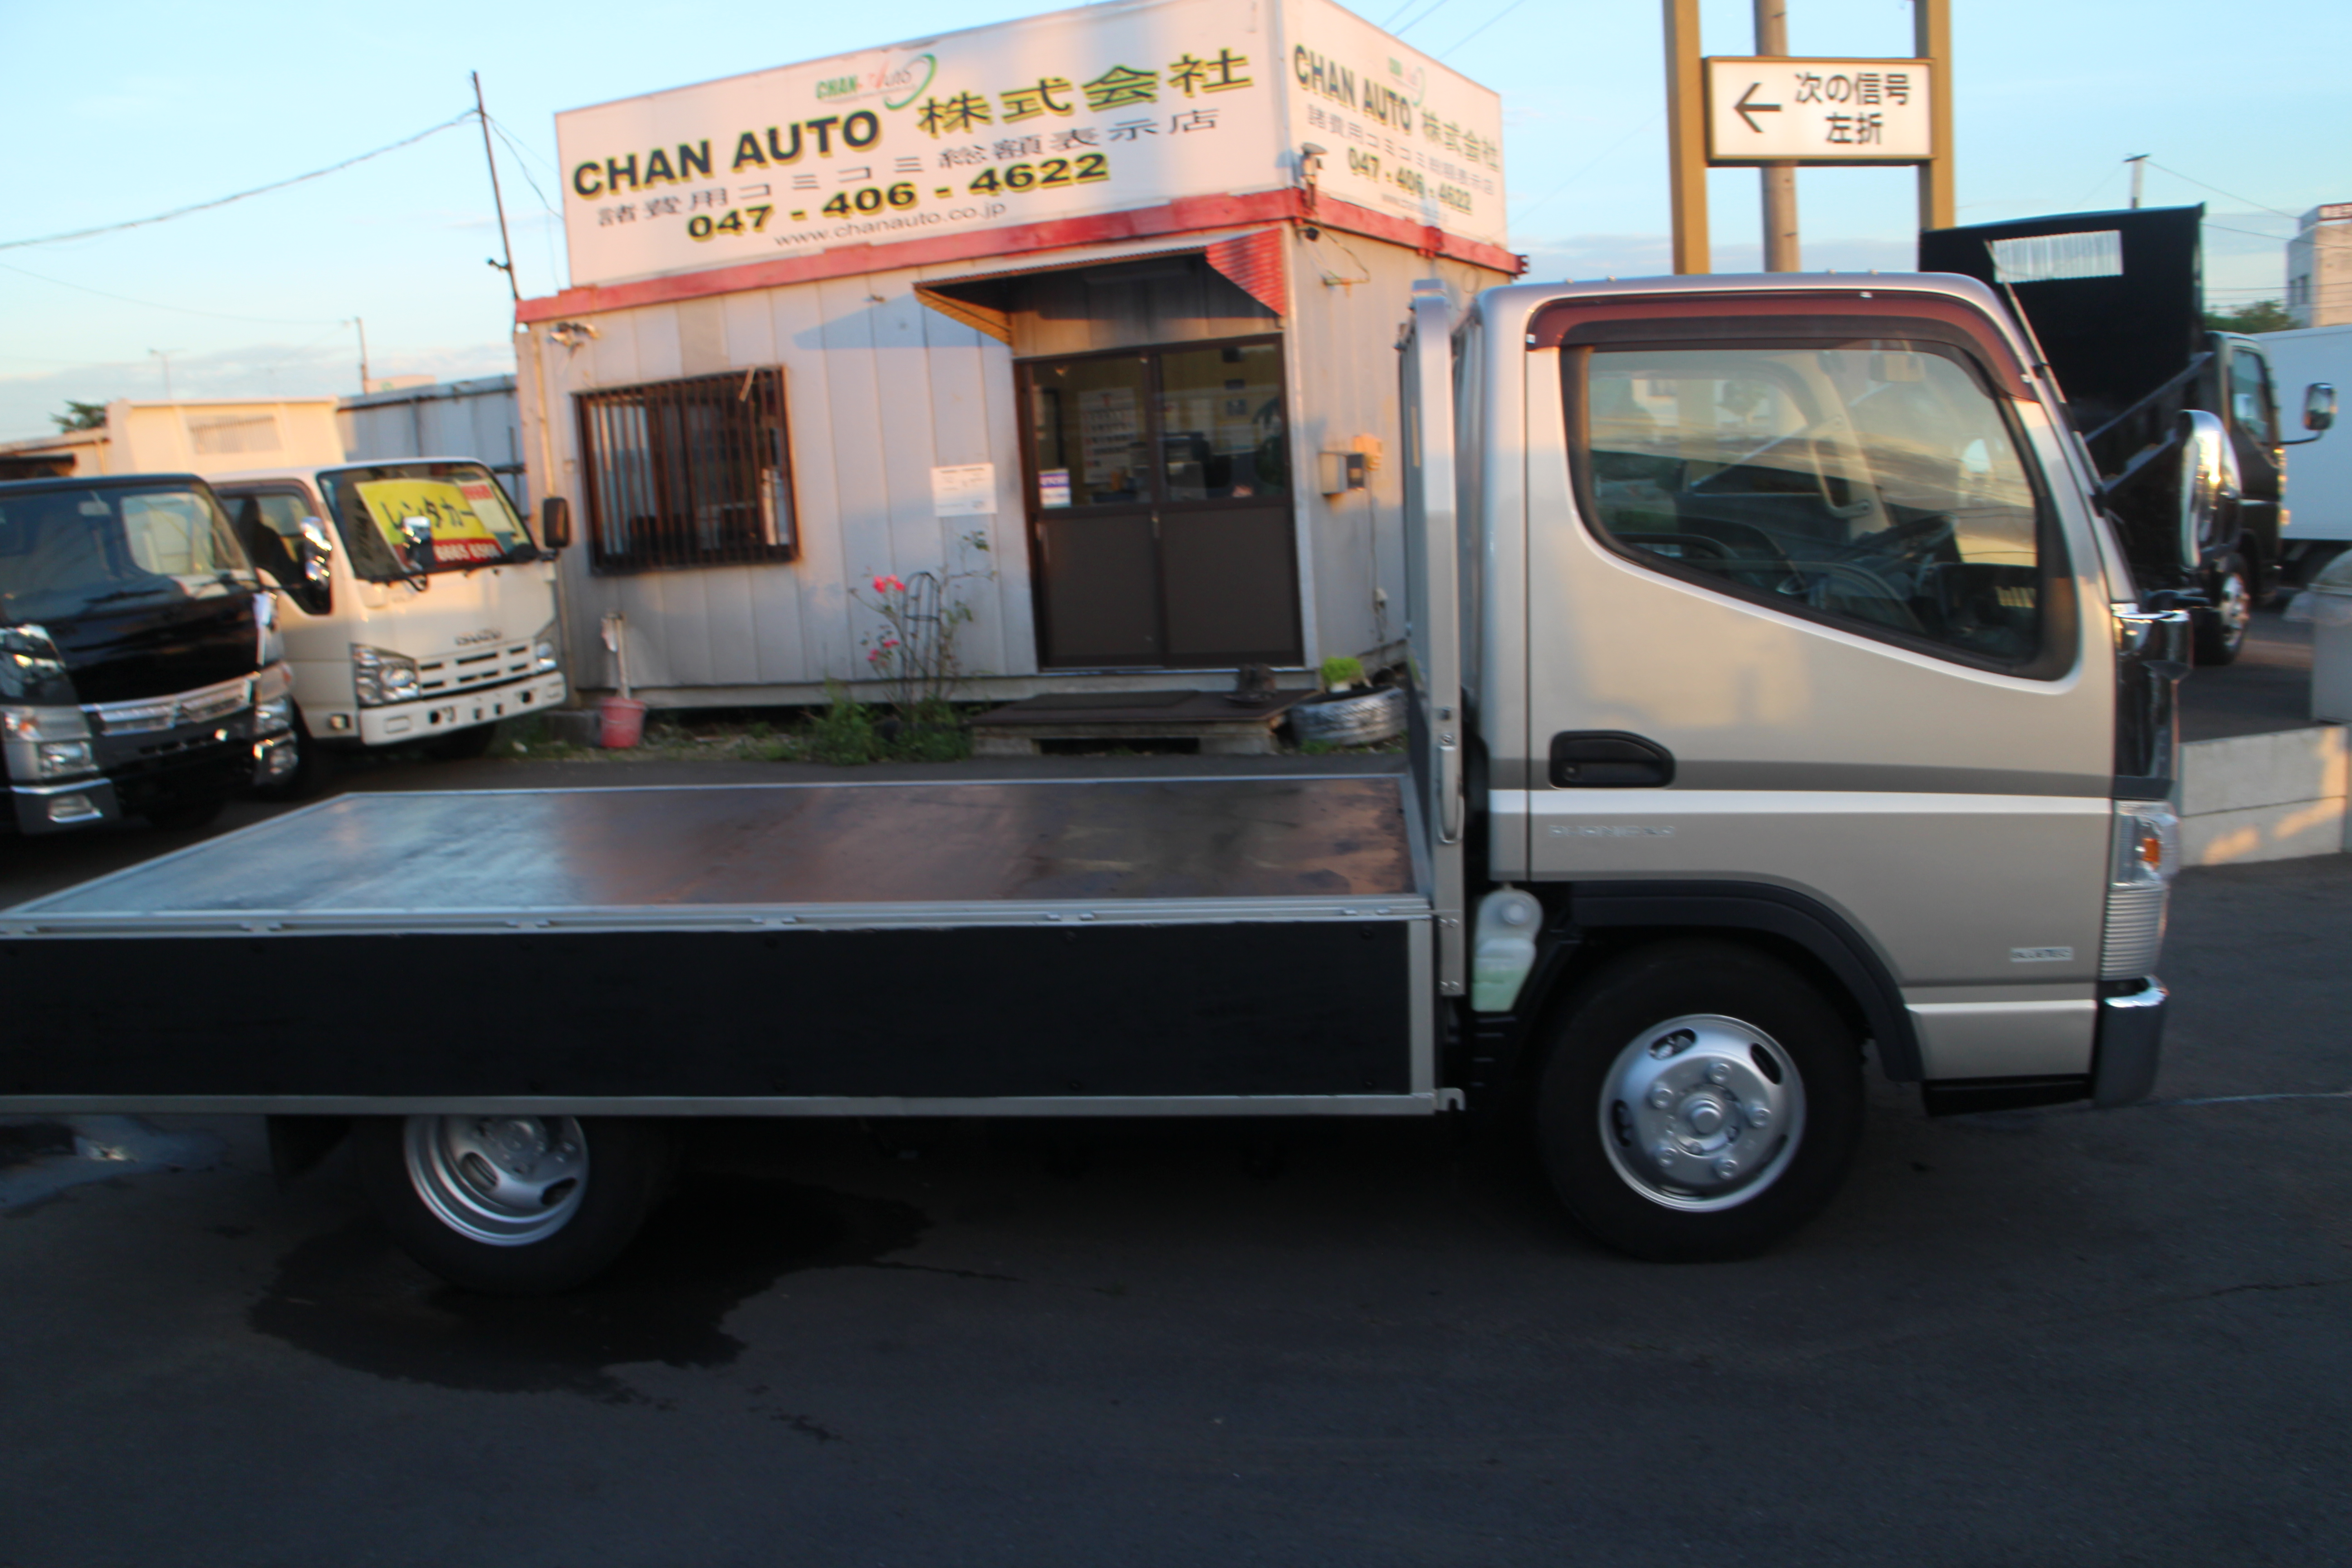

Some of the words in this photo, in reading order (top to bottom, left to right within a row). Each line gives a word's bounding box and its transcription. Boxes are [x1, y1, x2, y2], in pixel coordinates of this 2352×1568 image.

[1294, 44, 1357, 112] CHAN
[1363, 78, 1412, 136] AUTO
[1793, 72, 1911, 106] 次の信号
[573, 139, 713, 200] CHAN
[731, 110, 882, 174] AUTO
[916, 48, 1254, 139] 株式会社
[1825, 112, 1883, 145] 左折
[687, 204, 774, 242] 047
[821, 181, 919, 218] 406
[968, 152, 1111, 196] 4622
[774, 202, 1006, 247] www.chanauto.co.jp
